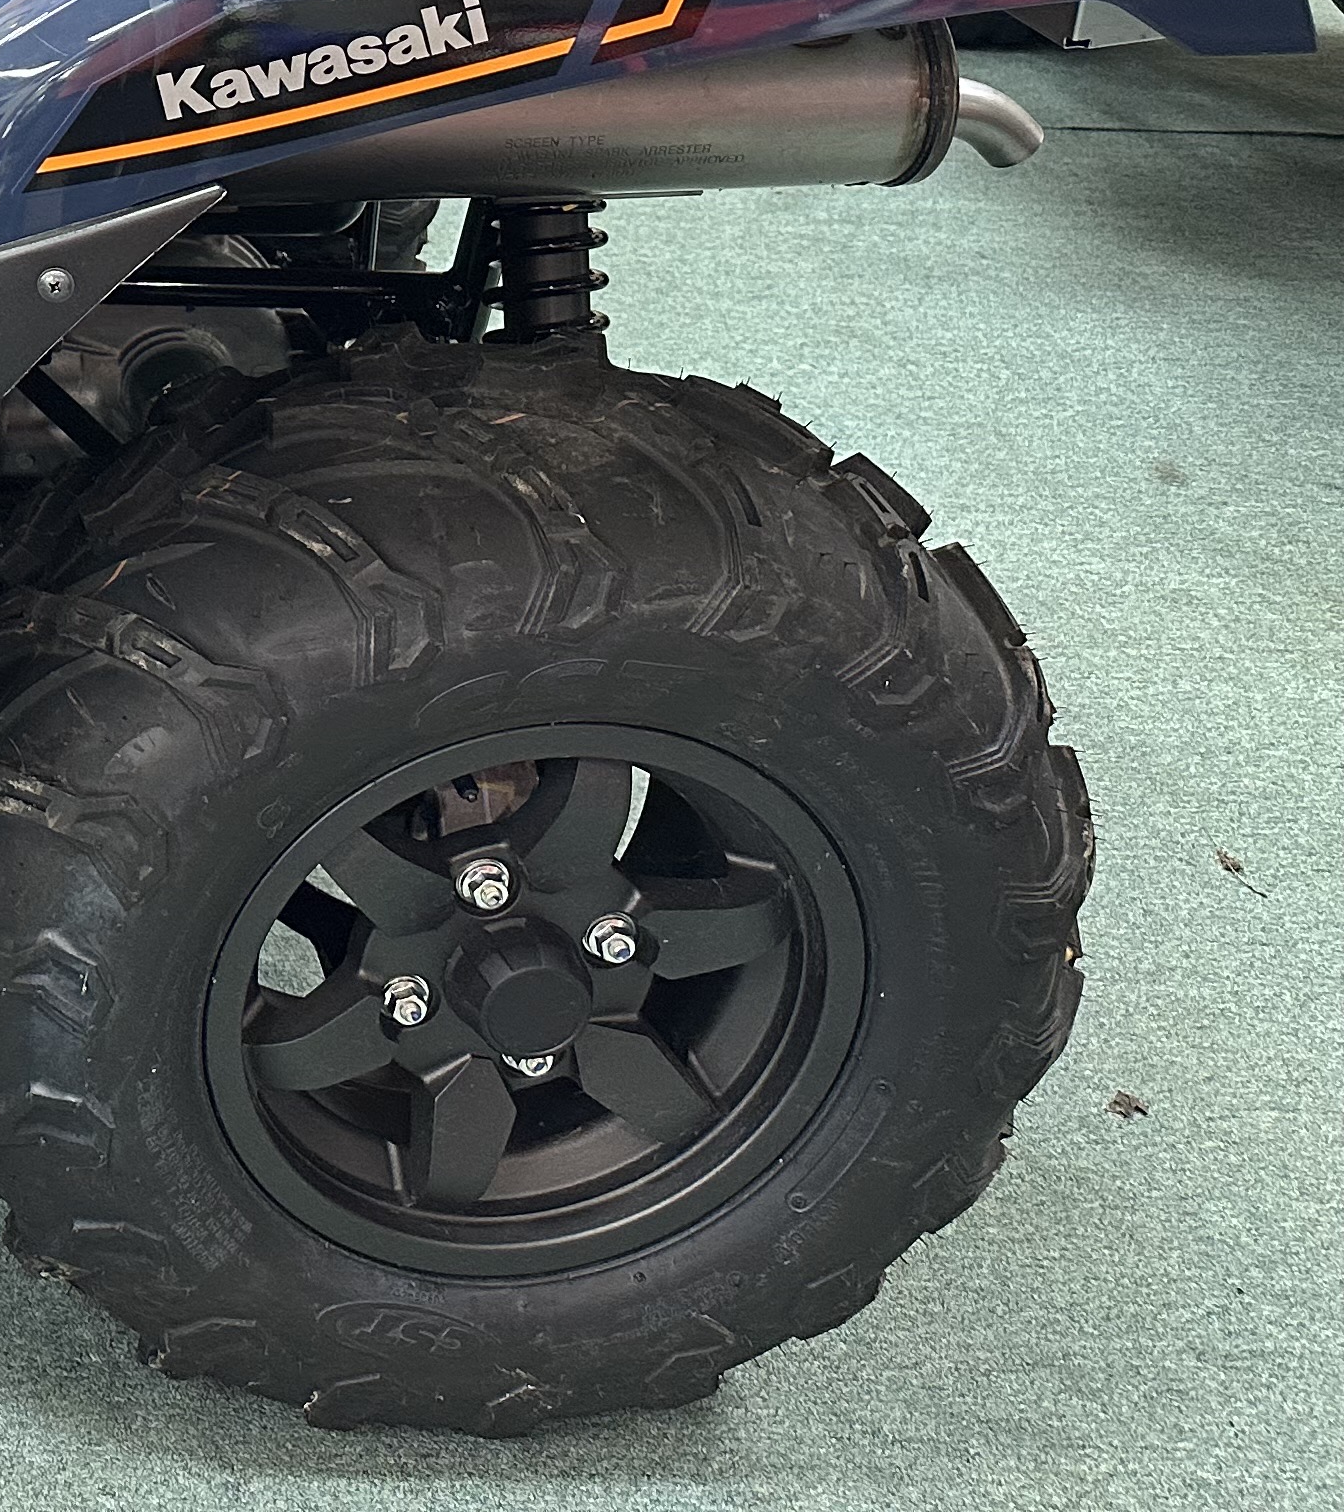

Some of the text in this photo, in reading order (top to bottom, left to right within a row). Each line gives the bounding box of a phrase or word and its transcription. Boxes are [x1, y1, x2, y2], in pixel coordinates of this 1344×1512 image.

[505, 135, 606, 150] SCREEN TYPE
[639, 143, 712, 156] ARRESTER
